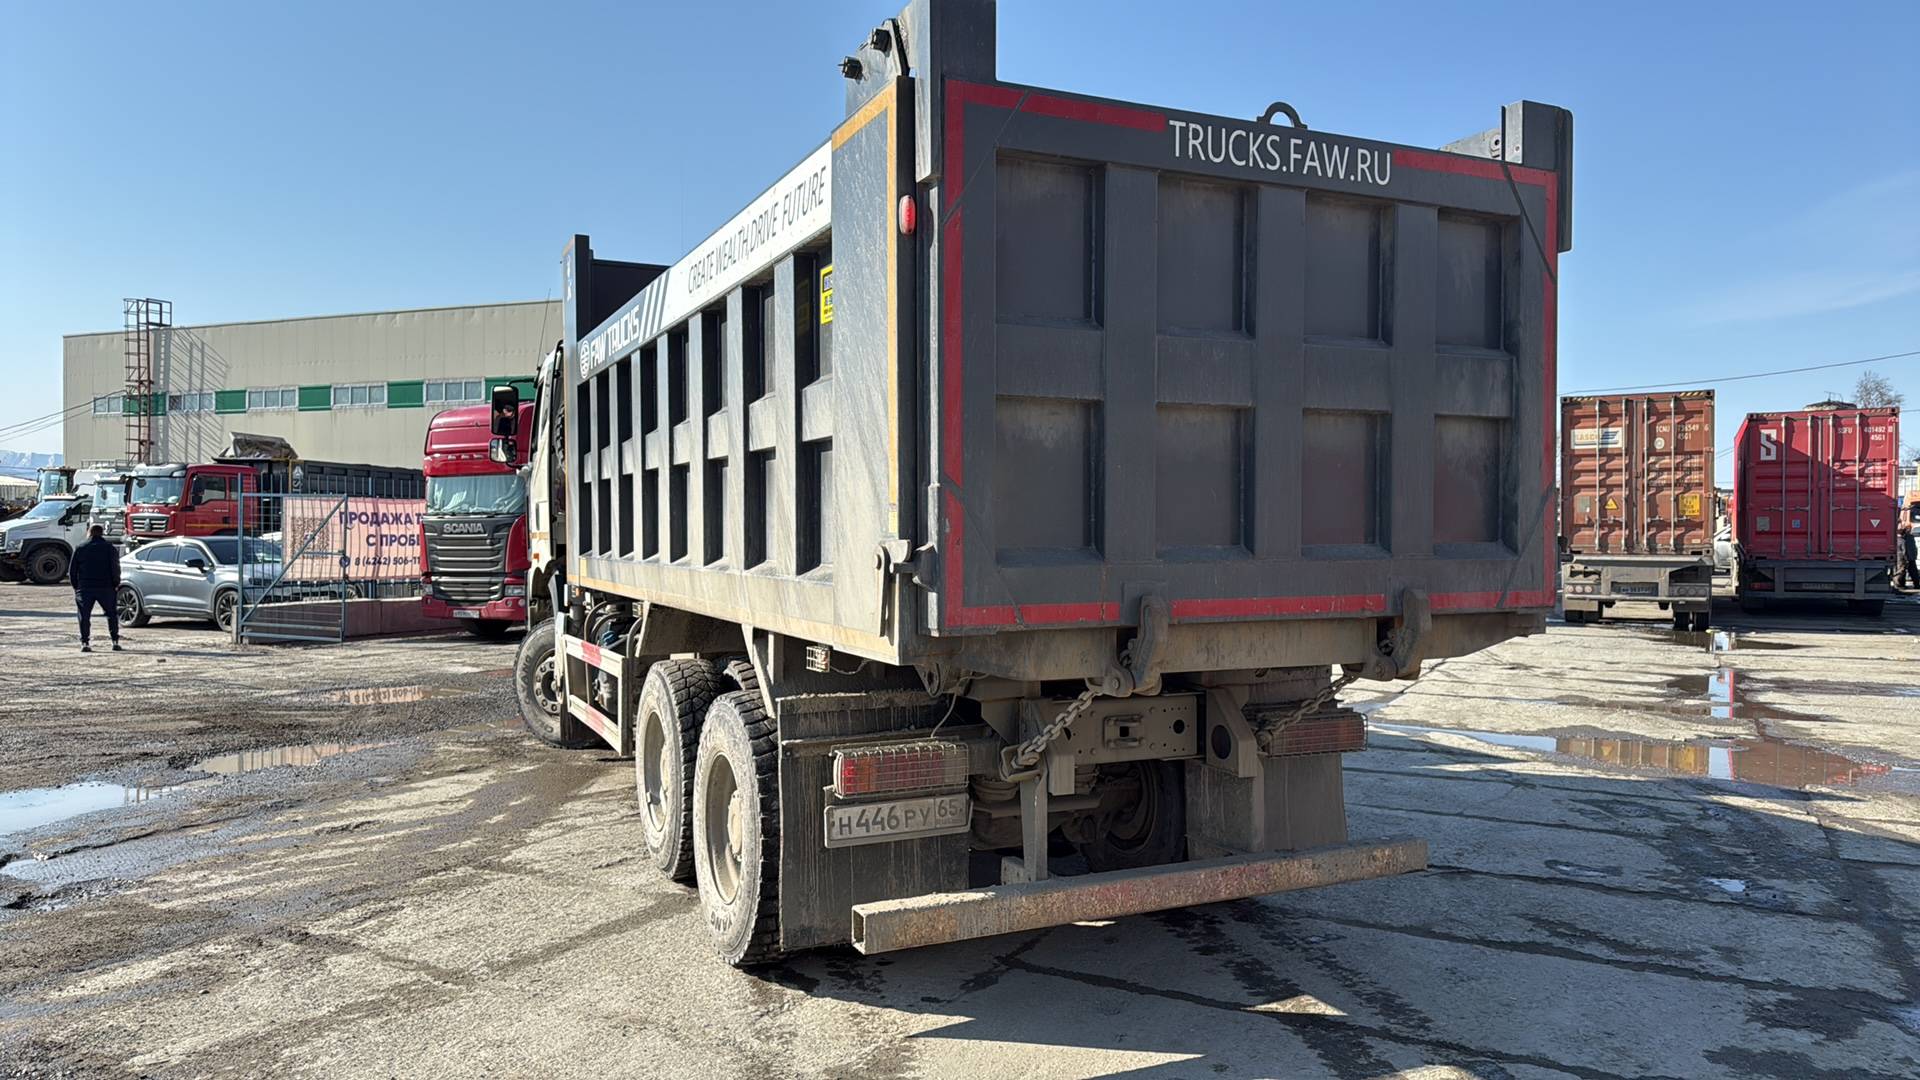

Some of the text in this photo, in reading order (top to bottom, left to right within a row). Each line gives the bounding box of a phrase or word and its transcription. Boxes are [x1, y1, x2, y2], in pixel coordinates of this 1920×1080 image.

[1168, 119, 1391, 186] TRUCKS.FAW.RU
[688, 250, 715, 294] CREATE
[782, 165, 827, 232] FUTURE
[590, 304, 640, 370] FAW TRUCKS
[339, 512, 411, 527] ПРОДАЖА
[443, 523, 484, 533] SCANIA
[366, 533, 377, 547] С
[937, 798, 958, 818] 65
